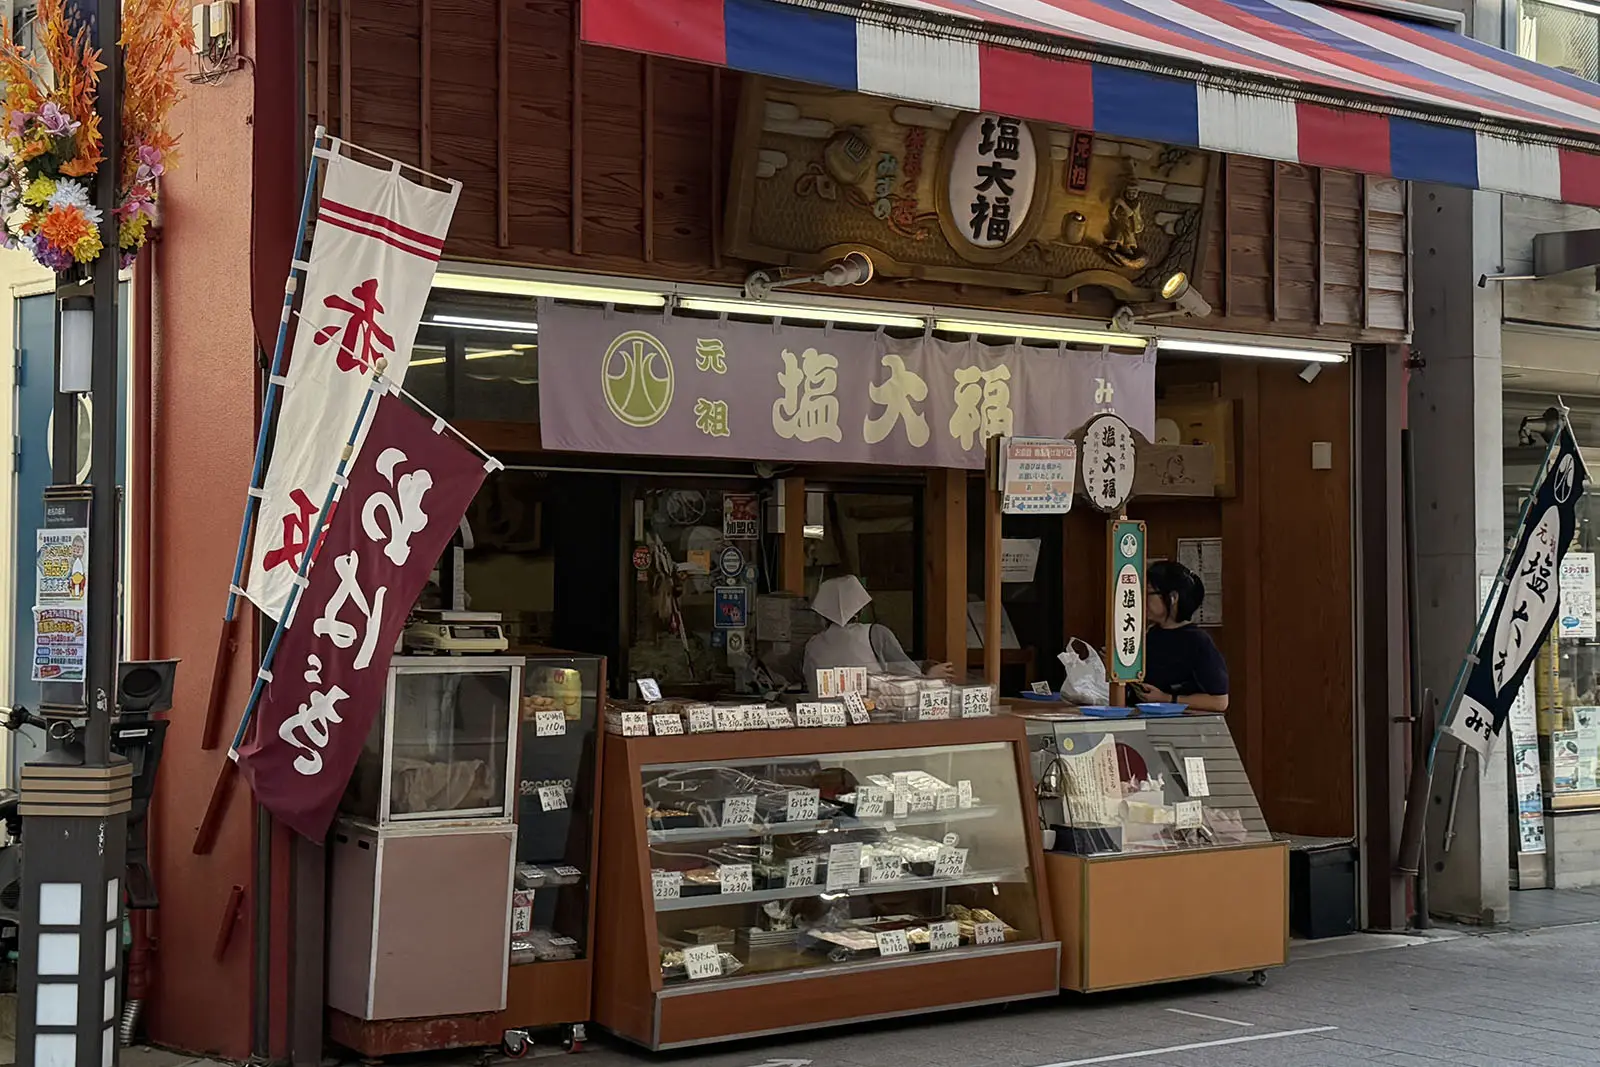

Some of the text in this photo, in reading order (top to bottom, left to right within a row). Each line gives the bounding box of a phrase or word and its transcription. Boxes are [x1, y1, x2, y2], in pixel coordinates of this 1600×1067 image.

[968, 115, 1022, 243] 塩大福
[1072, 133, 1090, 186] 元祖
[694, 337, 731, 437] 元祖
[771, 347, 1014, 452] 塩大福
[1101, 424, 1117, 499] 塩大福
[725, 519, 757, 535] 加盟店
[1121, 588, 1136, 656] 塩大福
[964, 693, 989, 705] 豆大福
[790, 796, 816, 808] おはぎ
